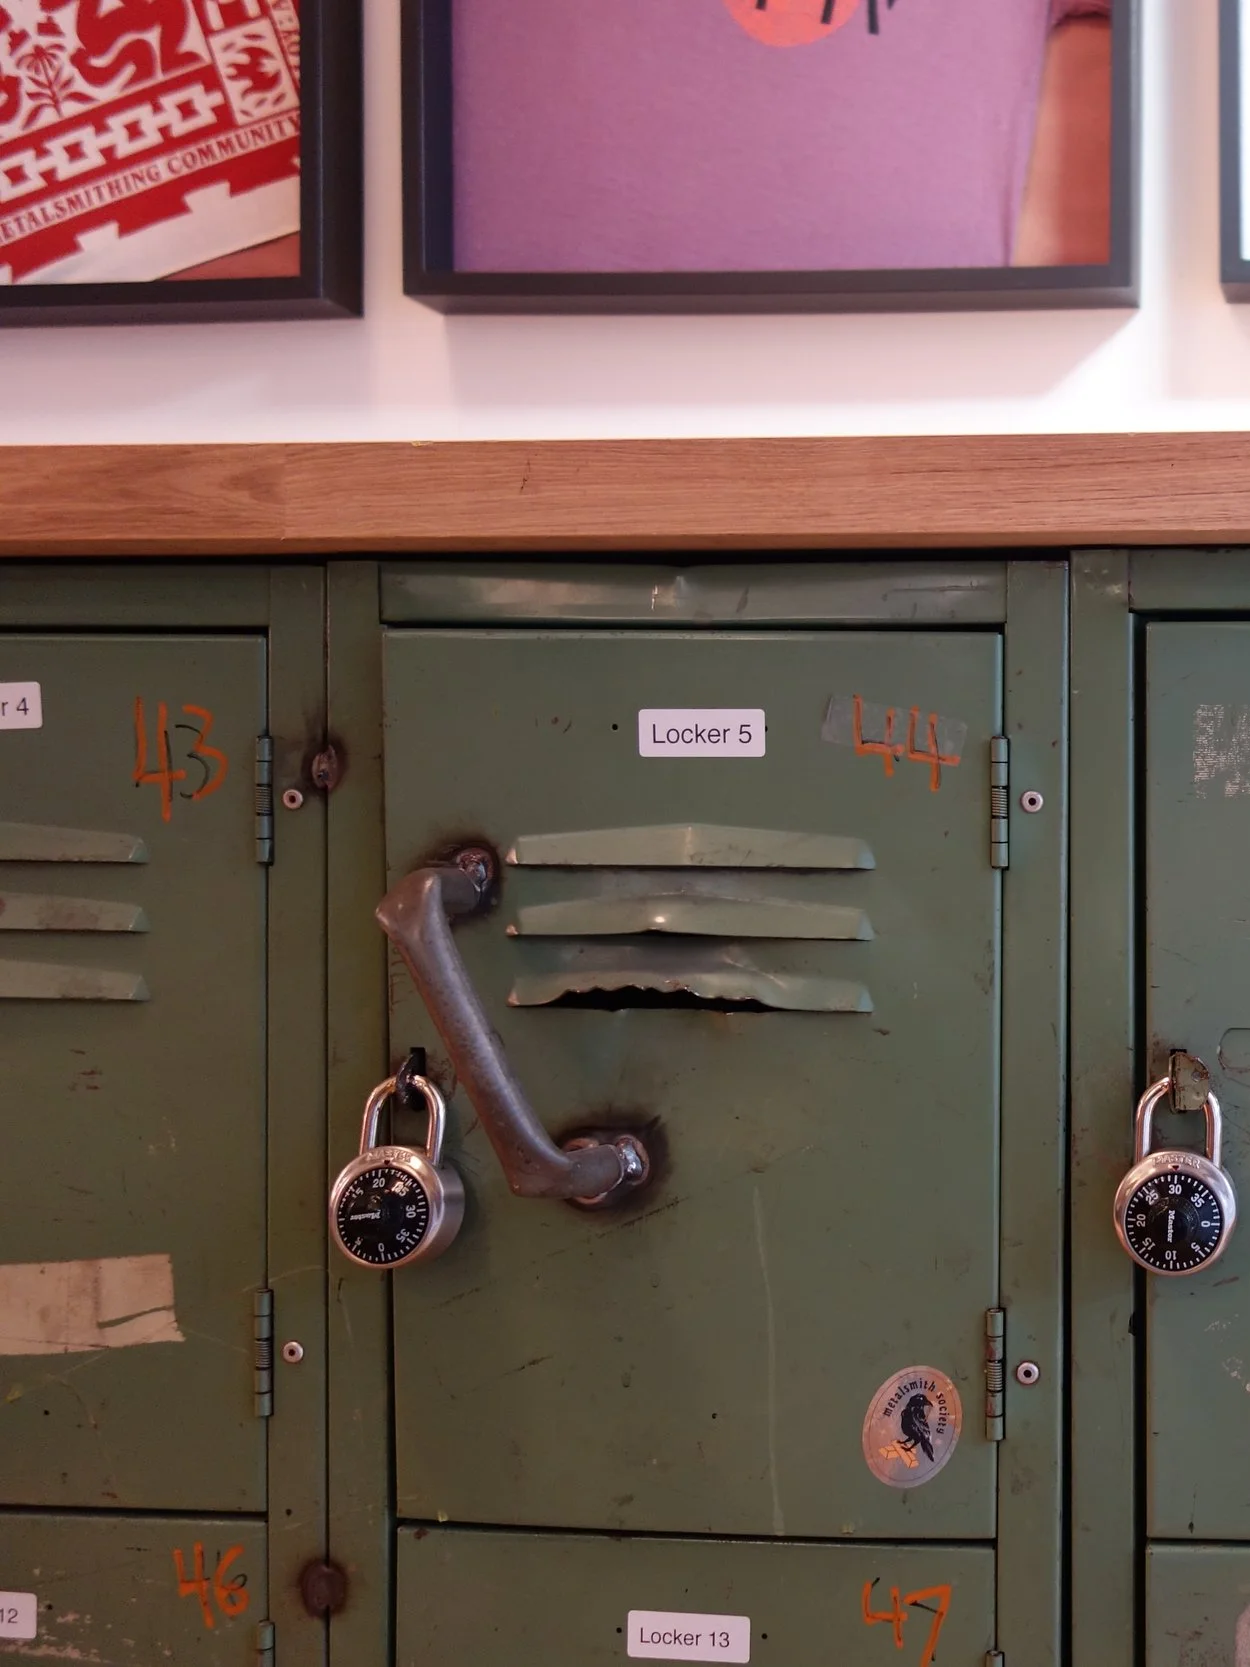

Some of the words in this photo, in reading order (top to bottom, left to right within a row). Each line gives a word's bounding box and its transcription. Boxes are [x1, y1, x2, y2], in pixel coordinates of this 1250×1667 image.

[0, 164, 161, 245] ETALSMITHING
[16, 696, 29, 716] 4
[652, 723, 730, 744] Locker
[738, 723, 752, 744] 5
[852, 694, 961, 792] 44
[133, 695, 229, 823] 43
[372, 1177, 386, 1189] 20
[1168, 1184, 1182, 1195] 30
[1145, 1189, 1159, 1205] 25
[1190, 1192, 1205, 1208] 35
[405, 1204, 416, 1219] 30
[1136, 1213, 1146, 1227] 20
[1167, 1209, 1176, 1244] Master
[1201, 1220, 1211, 1228] 0
[396, 1228, 410, 1244] 35
[1142, 1237, 1156, 1251] 15
[378, 1242, 385, 1252] 0
[1165, 1250, 1177, 1261] 10
[882, 1377, 937, 1417] metalsmith
[935, 1391, 950, 1435] society
[861, 1579, 953, 1667] 47
[639, 1627, 702, 1647] Locker
[708, 1631, 731, 1648] 13
